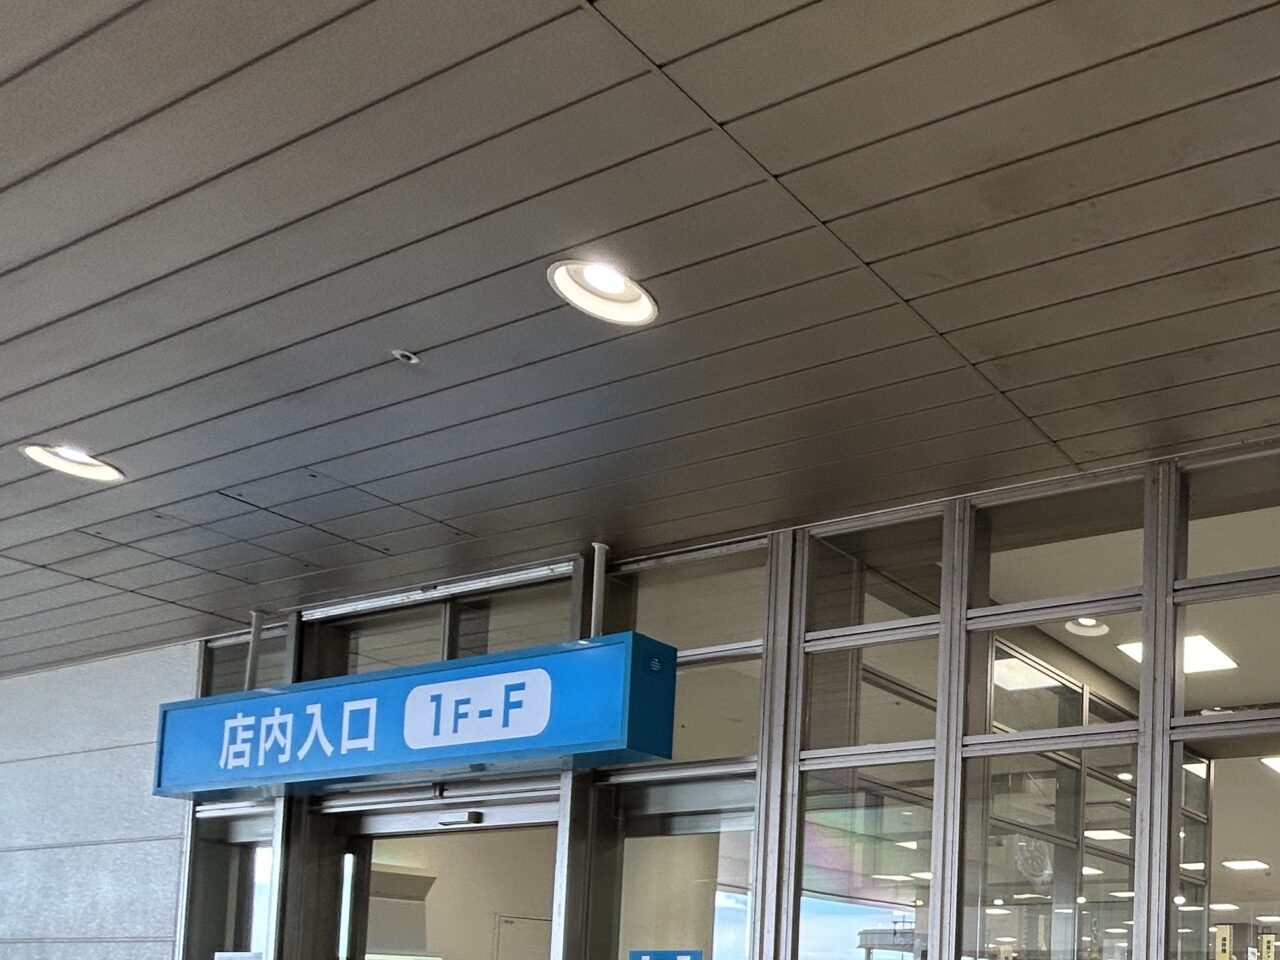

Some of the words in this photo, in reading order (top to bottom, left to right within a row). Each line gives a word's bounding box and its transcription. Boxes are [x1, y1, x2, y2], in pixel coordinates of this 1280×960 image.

[218, 697, 378, 769] 店内入口
[429, 681, 527, 737] 1F-F
